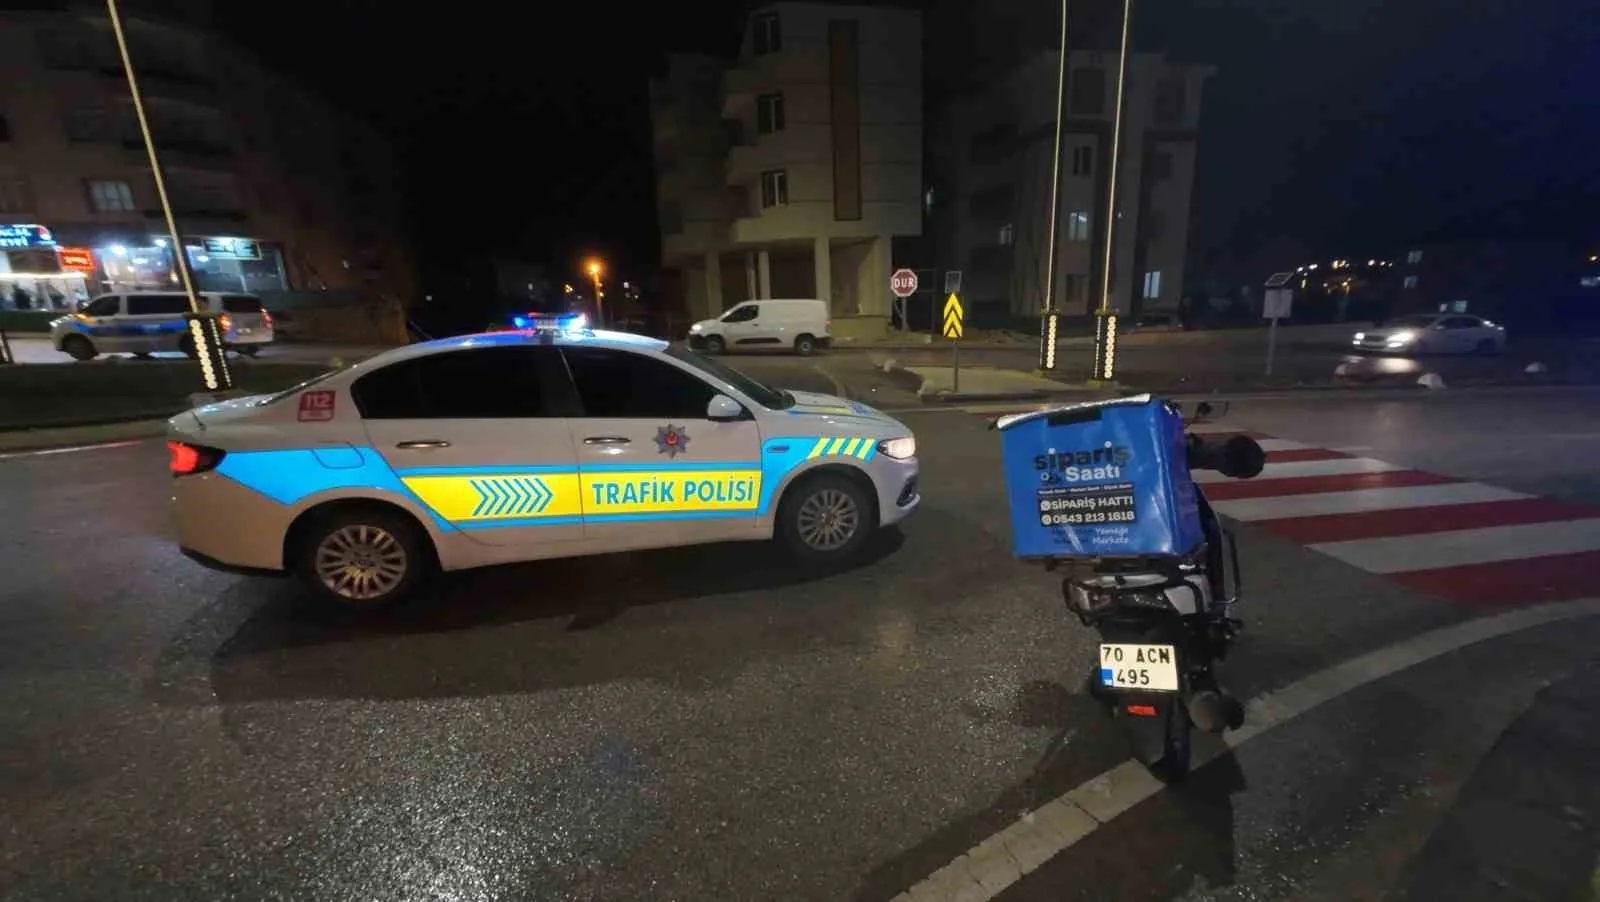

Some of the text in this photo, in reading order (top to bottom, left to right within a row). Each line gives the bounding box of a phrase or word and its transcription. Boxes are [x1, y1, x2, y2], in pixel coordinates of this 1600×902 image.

[894, 278, 914, 288] DUR
[305, 394, 331, 408] 112
[592, 474, 754, 505] TRAFİK POLİSİ
[1052, 495, 1133, 510] SİPARİŞ HATTI
[1053, 513, 1083, 524] 0543
[1085, 512, 1105, 522] 213
[1103, 647, 1170, 664] 70 ACN
[1117, 669, 1150, 685] 495
